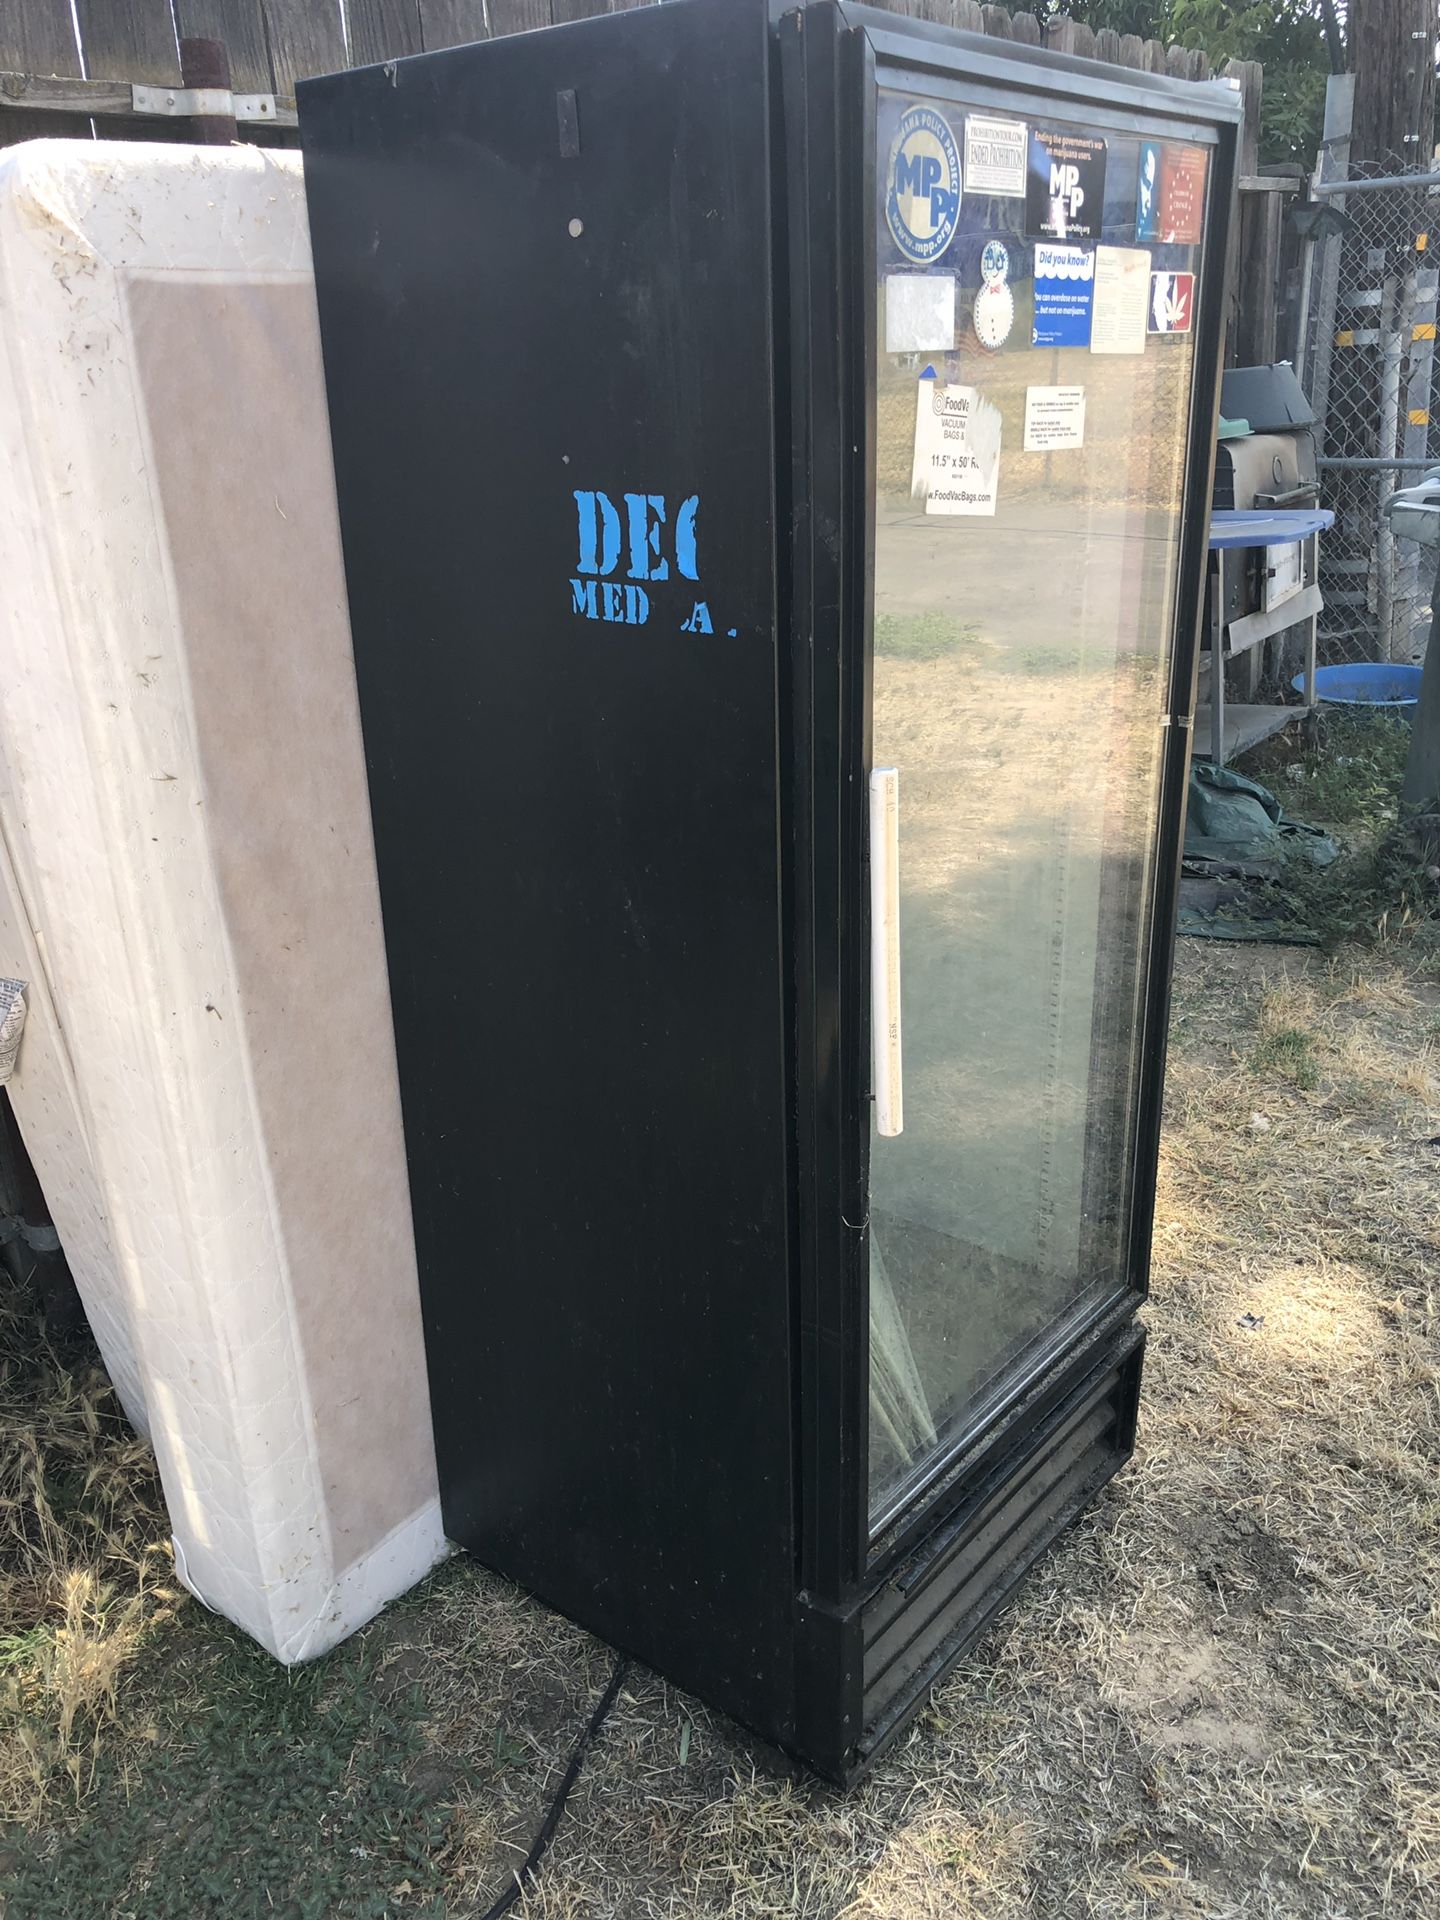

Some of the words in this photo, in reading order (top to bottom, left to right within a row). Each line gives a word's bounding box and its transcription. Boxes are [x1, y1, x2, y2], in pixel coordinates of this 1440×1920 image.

[1034, 131, 1052, 146] Ending
[1053, 133, 1061, 144] the
[1094, 141, 1103, 150] war
[922, 113, 946, 139] POLICY
[944, 138, 958, 195] PROJECT
[1053, 147, 1077, 160] marijuana
[892, 212, 952, 257] www.mpp.org
[1039, 251, 1052, 264] Did
[1052, 254, 1066, 267] you
[1067, 252, 1090, 267] know?
[1050, 292, 1070, 303] overdose
[1071, 295, 1077, 303] on
[1077, 295, 1090, 303] water
[1040, 305, 1048, 314] but
[1048, 307, 1057, 315] not
[941, 418, 966, 430] VACUUM
[943, 429, 960, 441] BAGS
[960, 431, 965, 441] &
[952, 458, 957, 468] x
[569, 579, 649, 625] MED
